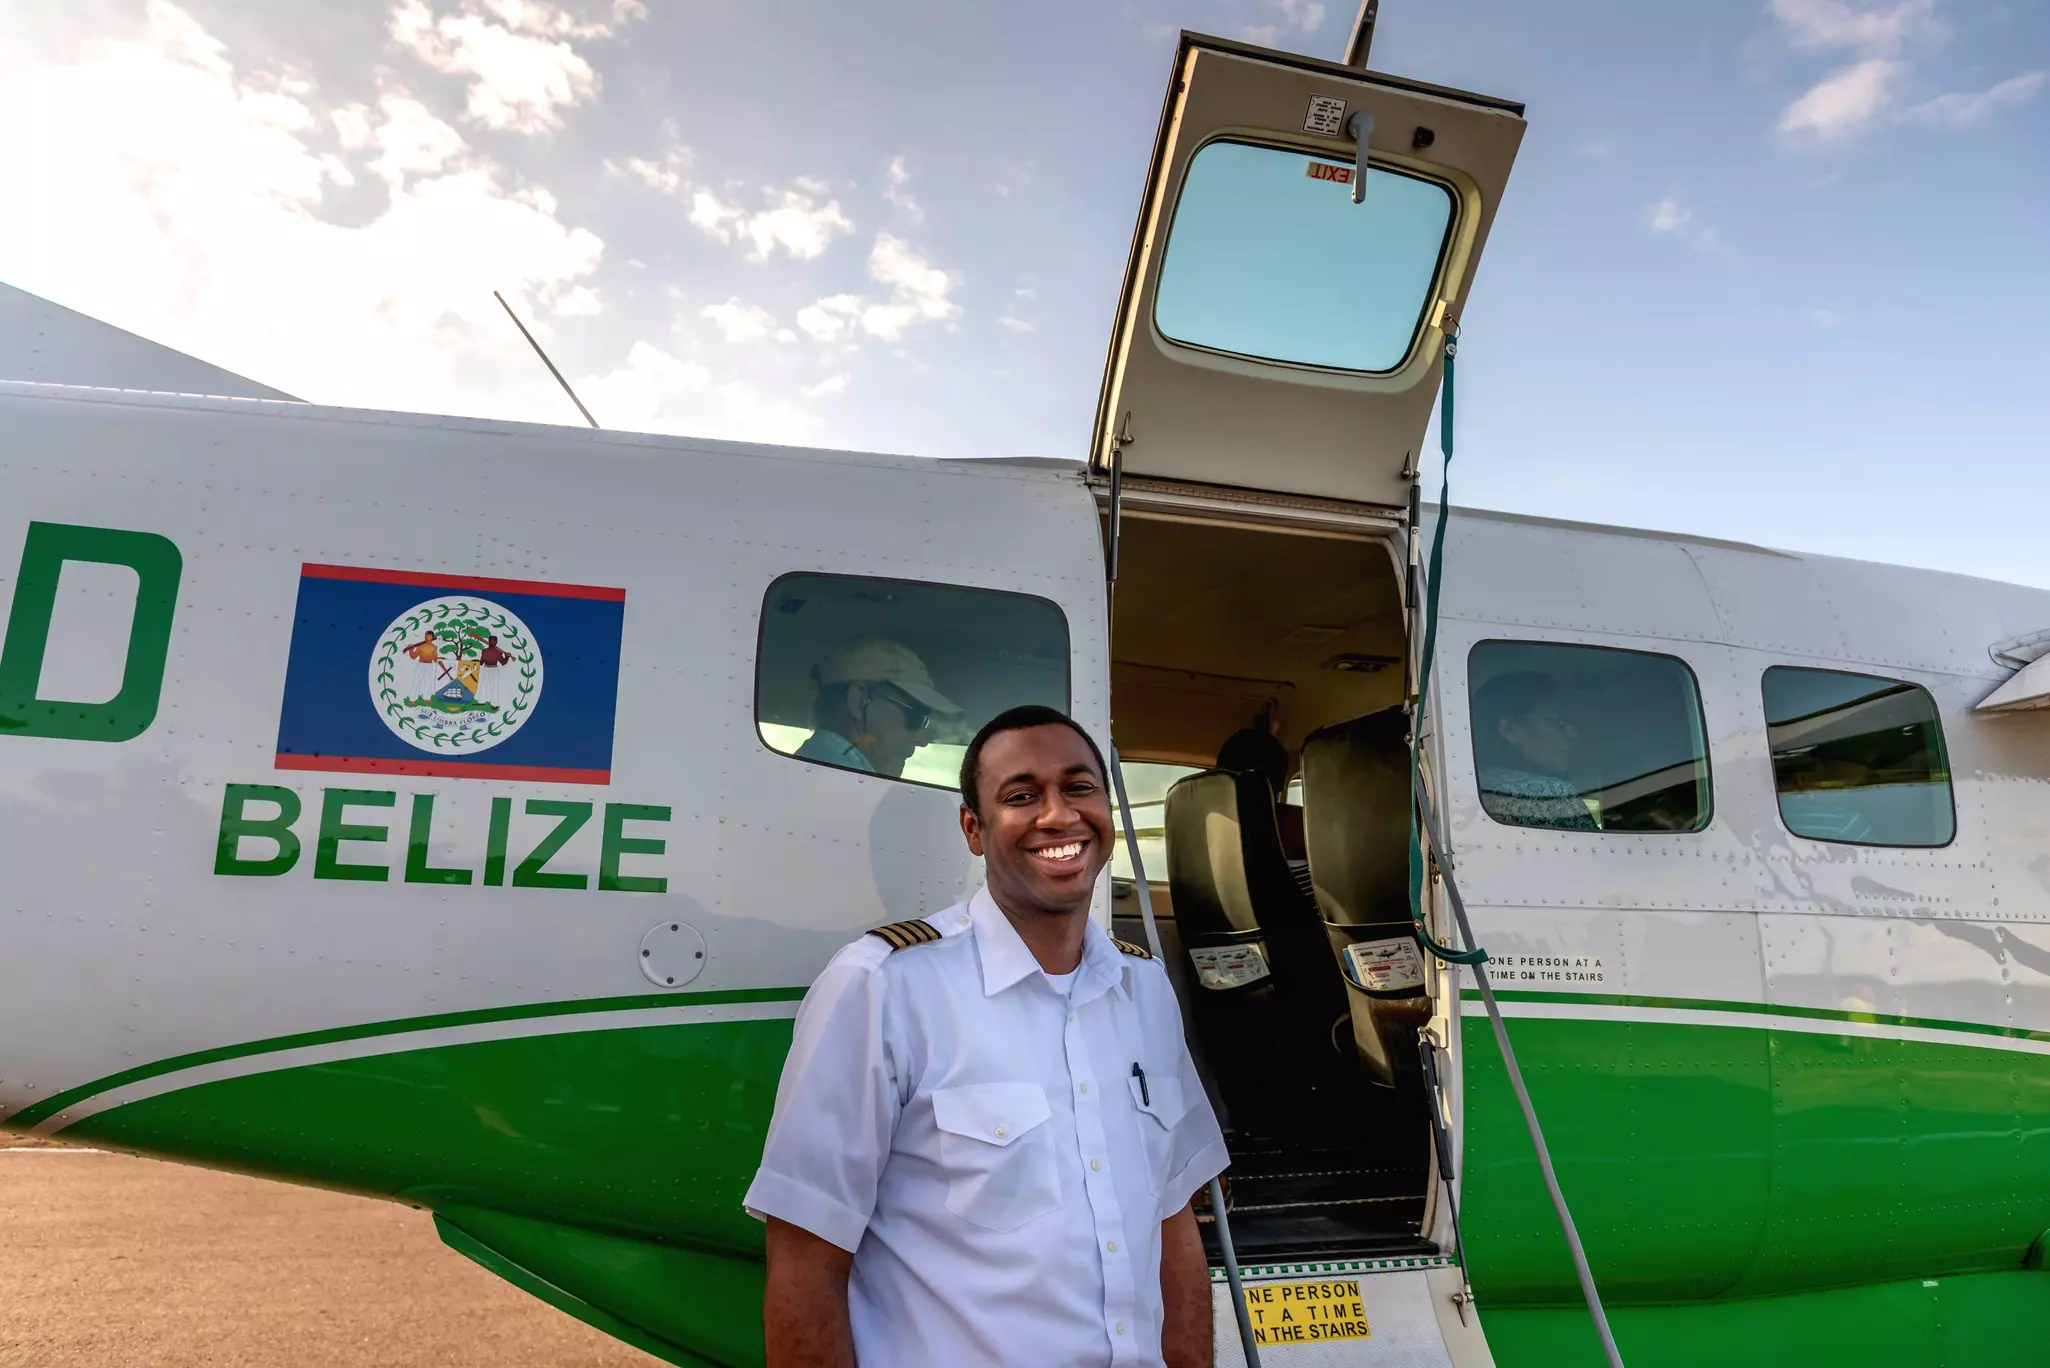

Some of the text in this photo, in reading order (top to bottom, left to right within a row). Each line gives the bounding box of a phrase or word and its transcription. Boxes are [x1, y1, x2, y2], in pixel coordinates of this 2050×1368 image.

[1311, 163, 1350, 184] EXIT
[0, 520, 183, 743] D
[213, 782, 672, 894] BELIZE
[1489, 957, 1602, 967] ONE PERSON AT A
[1490, 971, 1603, 982] TIME ON THE STAIRS
[1244, 1282, 1359, 1304] NE PERSON
[1254, 1303, 1364, 1324] T A TIME
[1254, 1321, 1368, 1343] N THE STAIRS
